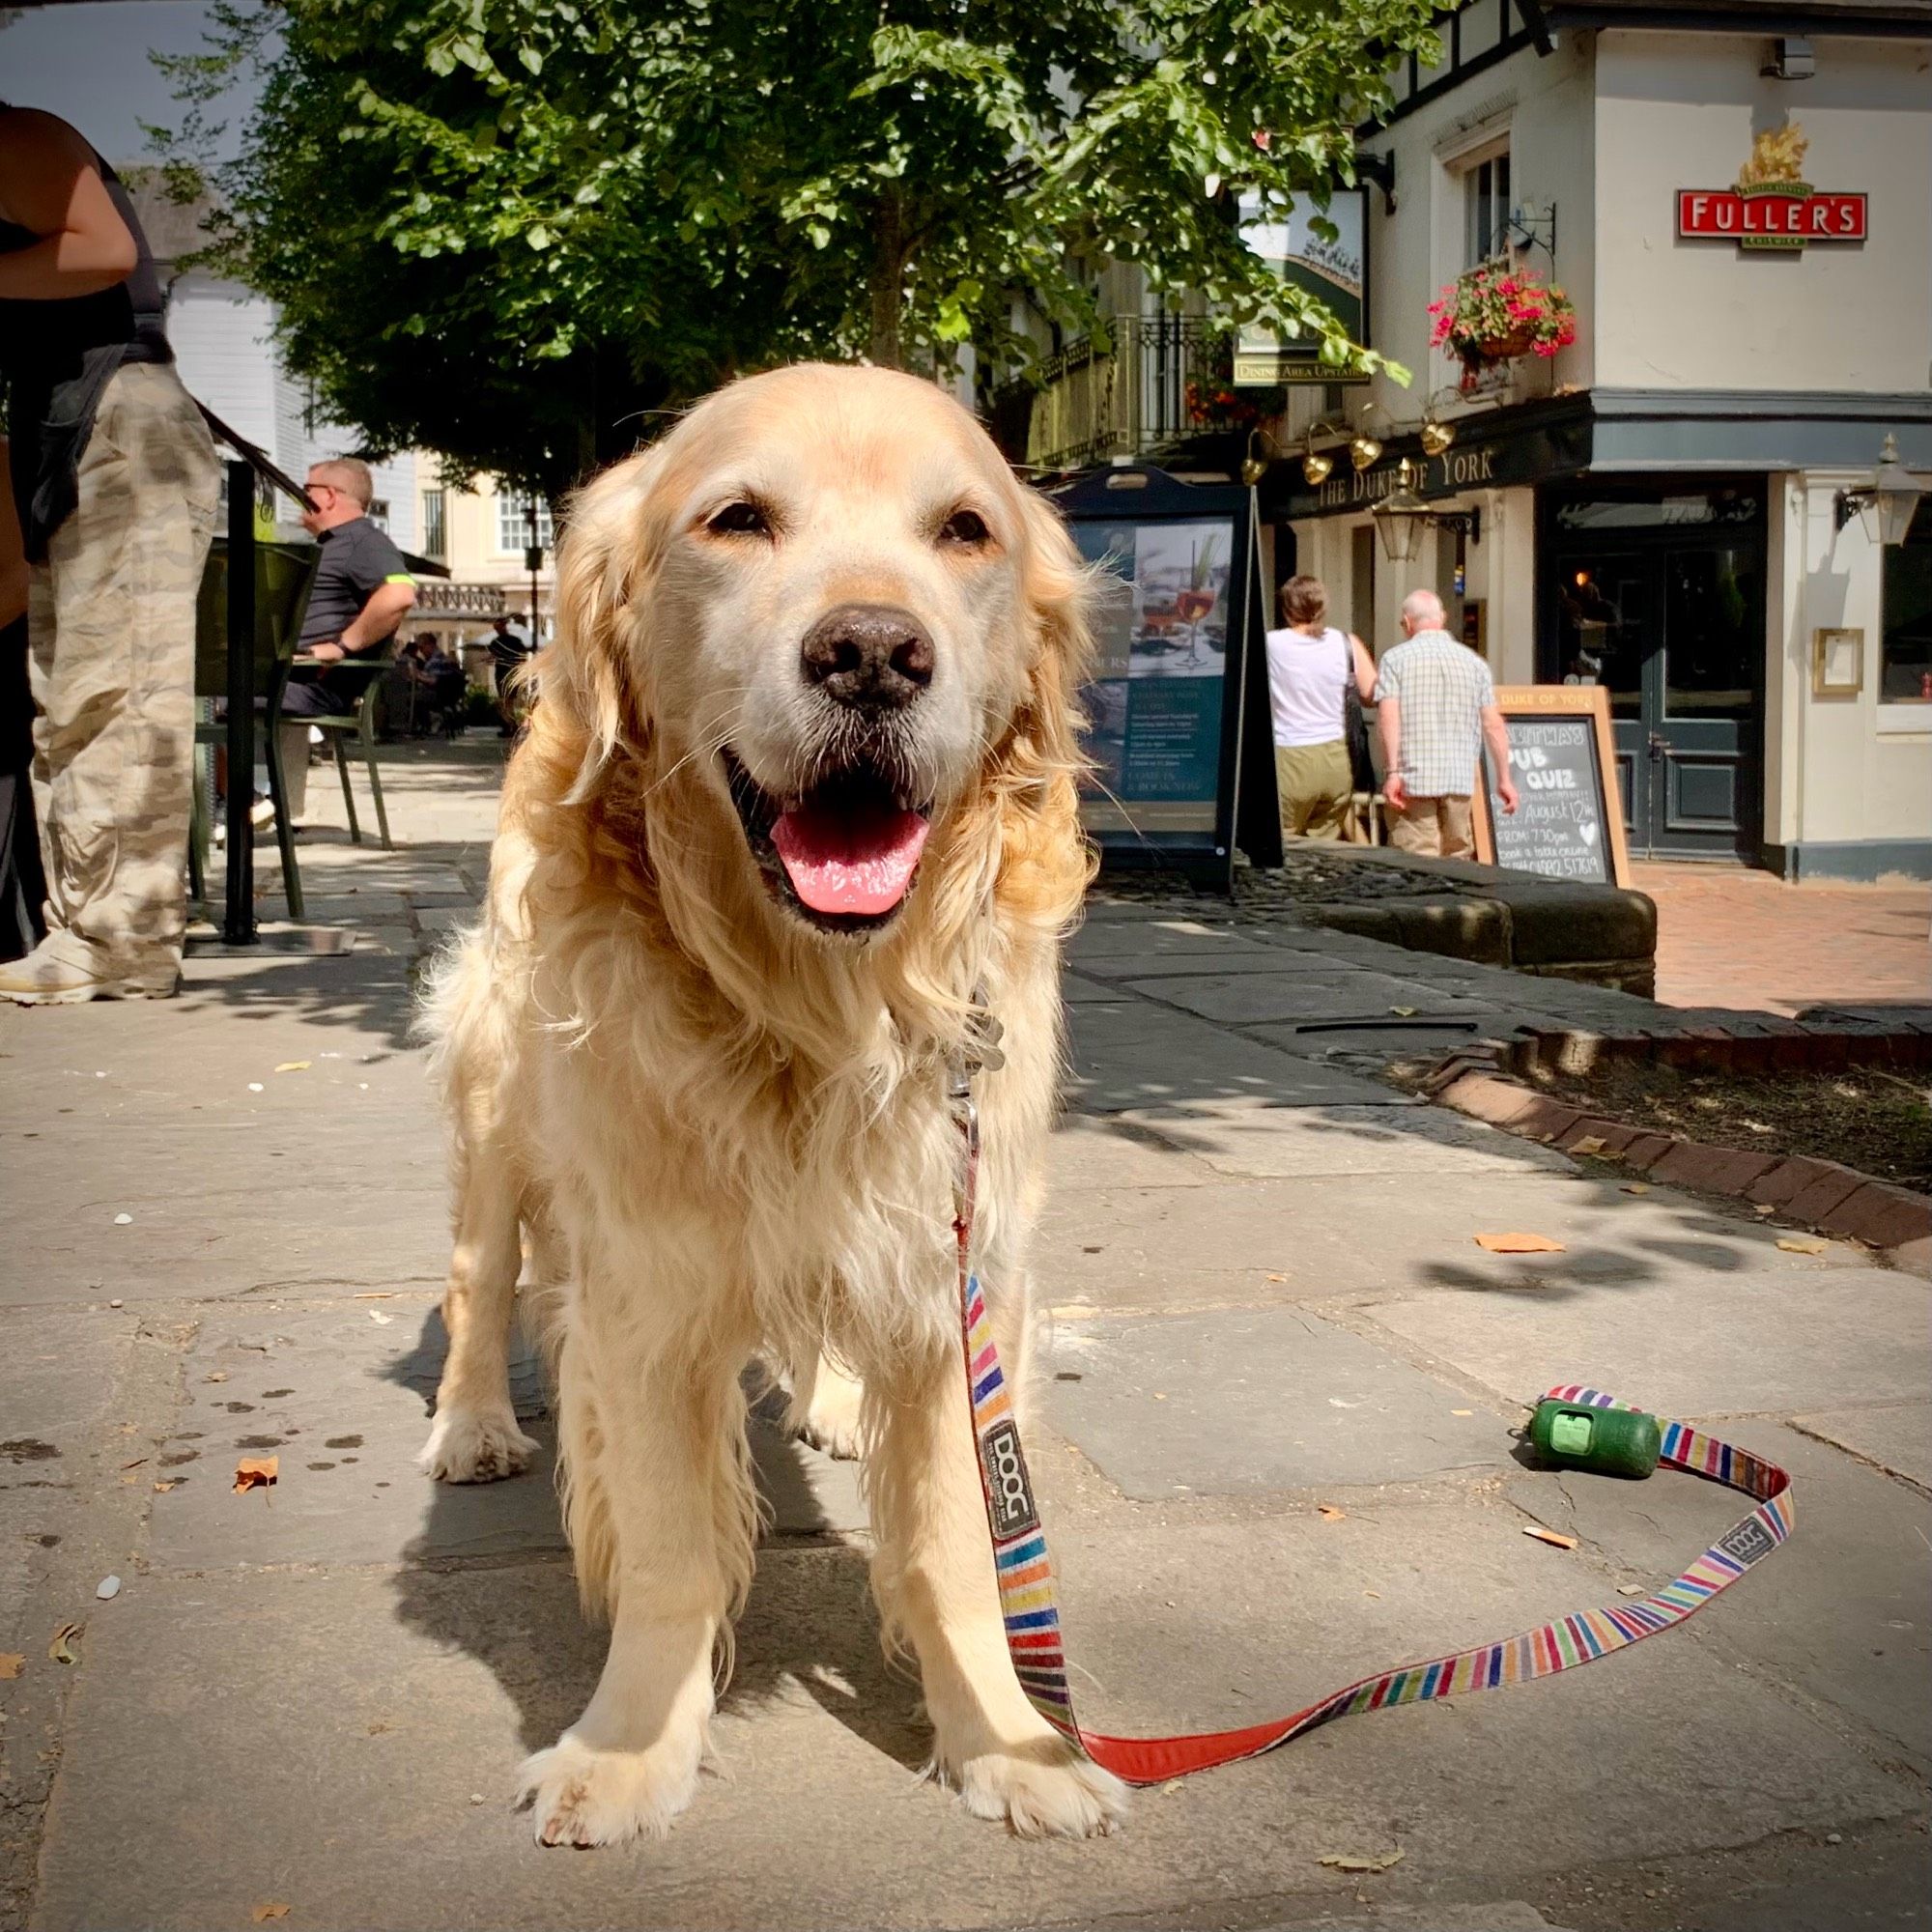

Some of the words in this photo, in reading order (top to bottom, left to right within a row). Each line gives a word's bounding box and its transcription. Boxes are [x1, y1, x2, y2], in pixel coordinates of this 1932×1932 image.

[1692, 196, 1855, 235] FULLER'S
[1282, 364, 1313, 379] AREA
[1320, 479, 1346, 506] THE
[1353, 469, 1397, 500] DUKE
[1406, 463, 1428, 493] OF
[1441, 450, 1494, 485] YORK
[1501, 694, 1531, 705] DUKE
[1539, 694, 1554, 705] OF
[1561, 694, 1593, 706] YORK
[1526, 769, 1577, 790] QUIZ
[1524, 802, 1569, 824] August
[994, 1433, 1029, 1520] DOOG
[1725, 1523, 1764, 1555] DOOG
